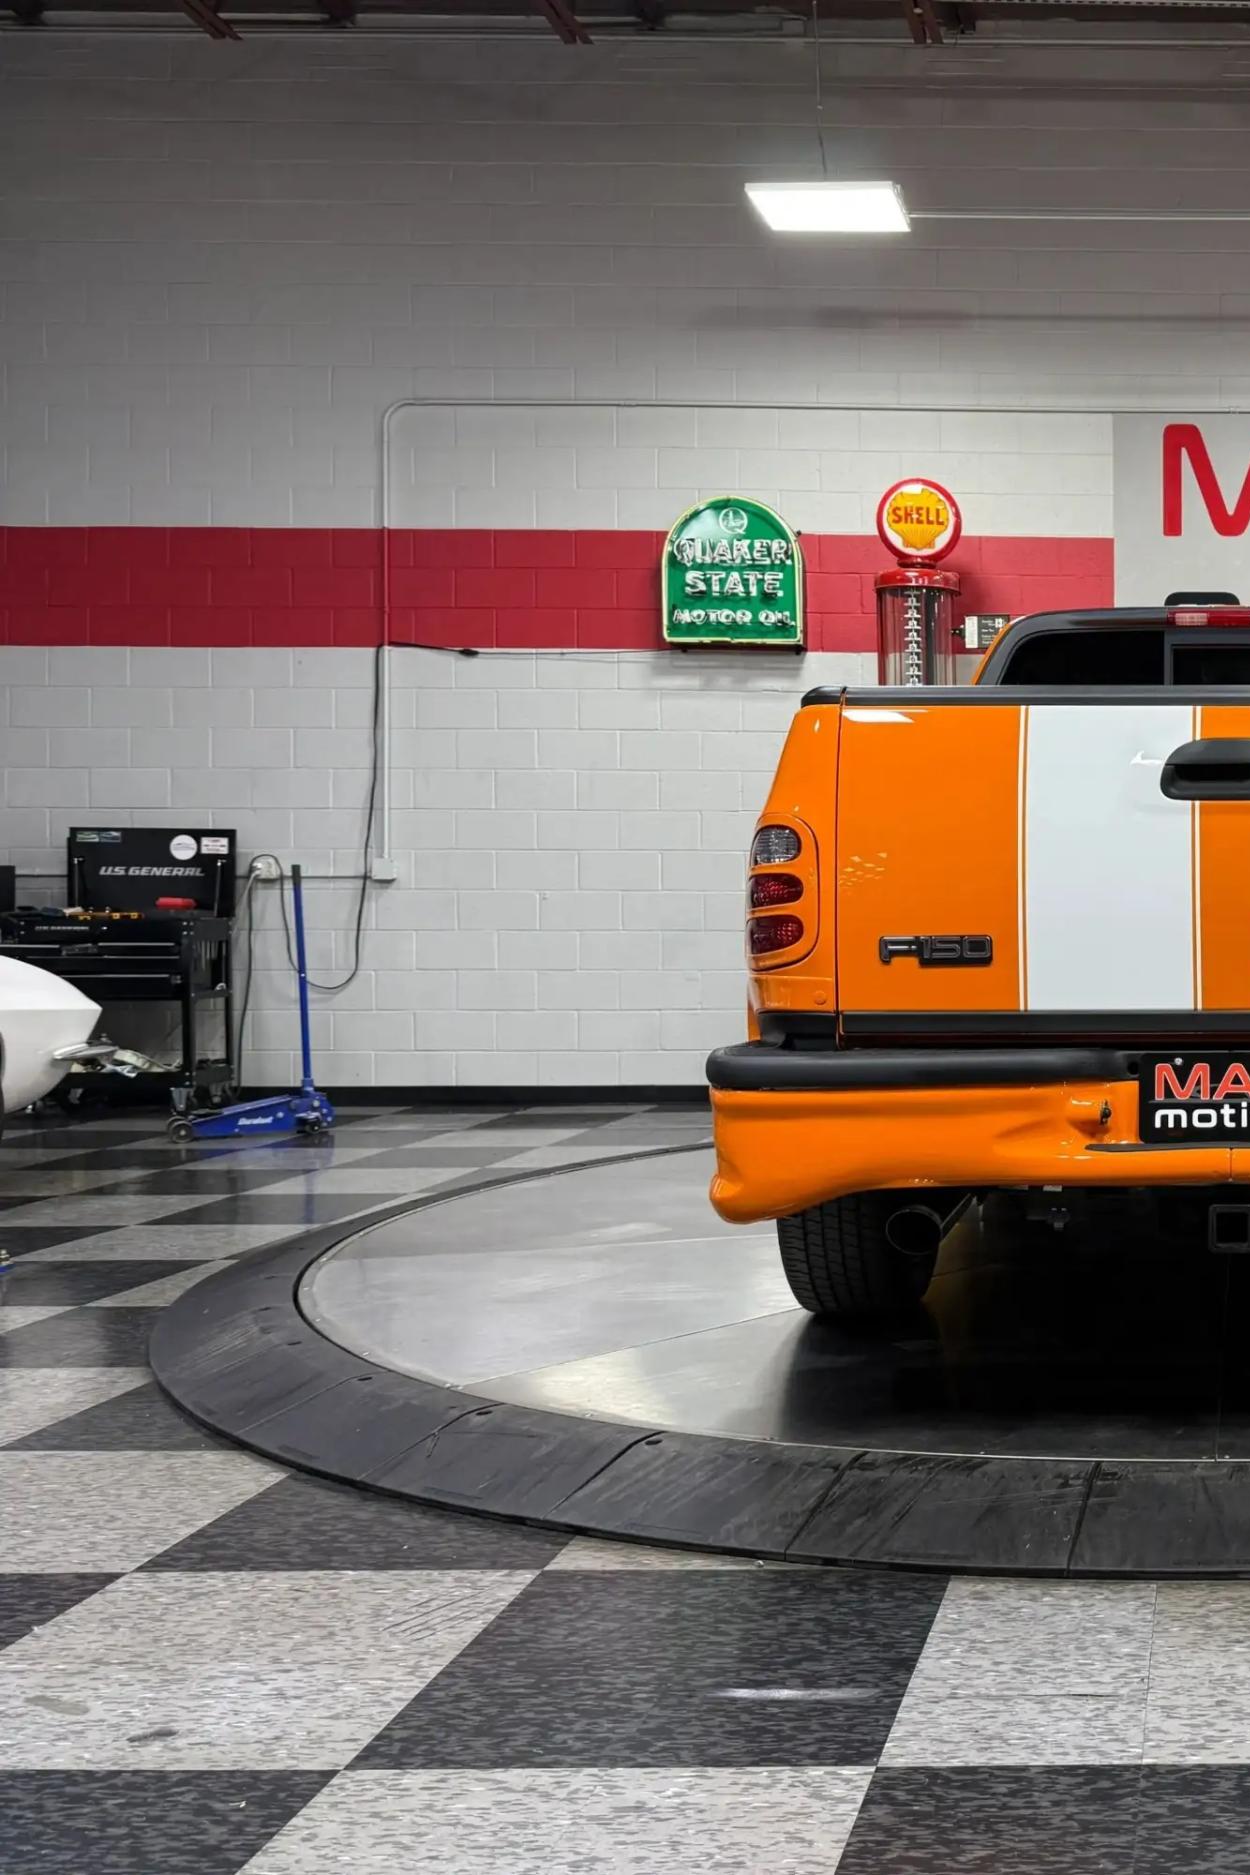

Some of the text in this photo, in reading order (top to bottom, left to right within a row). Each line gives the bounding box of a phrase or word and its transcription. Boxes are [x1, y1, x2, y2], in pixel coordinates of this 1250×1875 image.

[891, 506, 945, 526] SHELL
[673, 538, 793, 567] QUAKER
[684, 570, 784, 597] STATE
[672, 608, 753, 625] MOTOR
[127, 866, 205, 877] GENERAL
[879, 935, 993, 966] F-150
